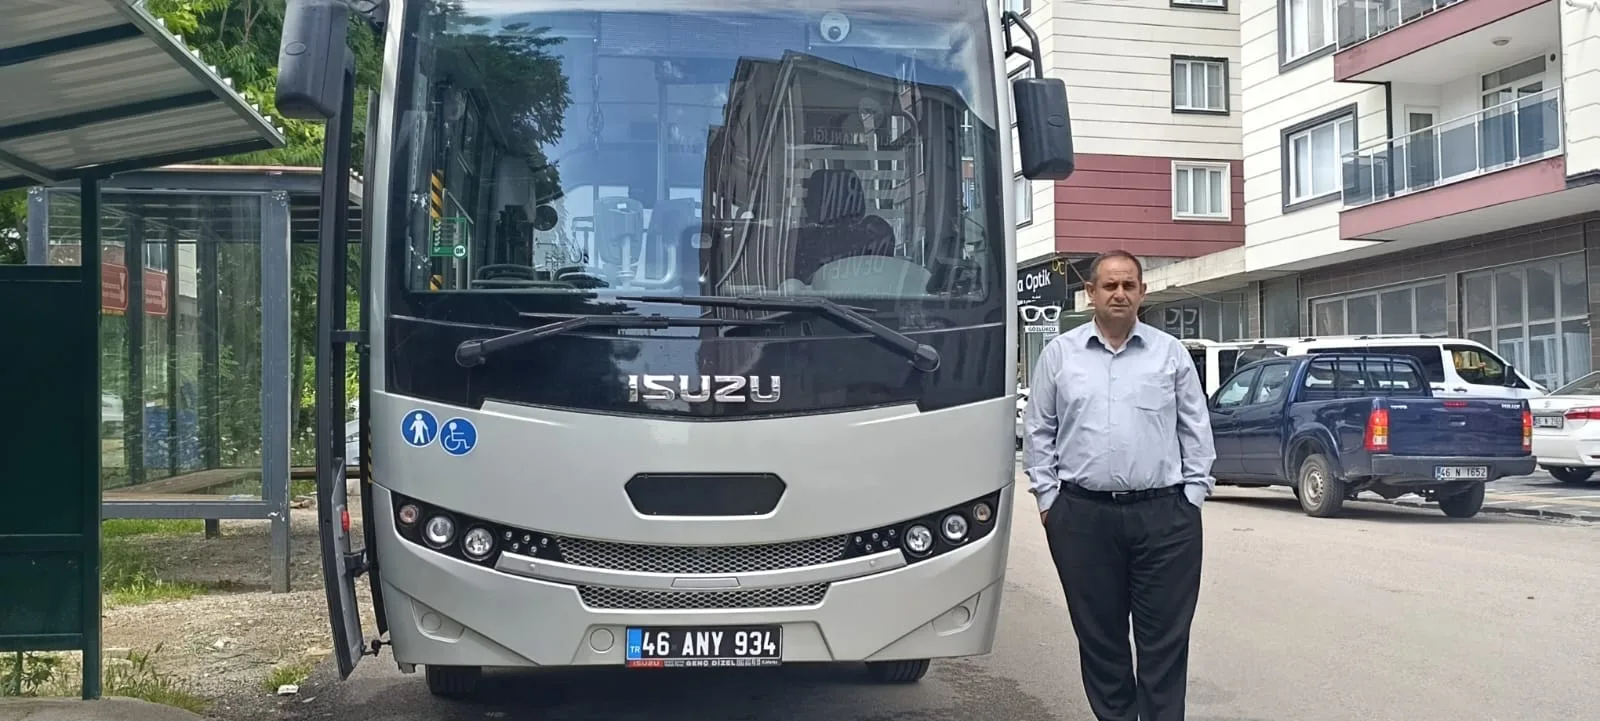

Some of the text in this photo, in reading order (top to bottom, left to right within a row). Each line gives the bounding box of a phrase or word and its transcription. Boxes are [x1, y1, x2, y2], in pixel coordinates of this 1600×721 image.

[1017, 268, 1052, 293] a Optik
[628, 374, 781, 403] ISUZU
[1440, 467, 1486, 477] 46 N 1652
[629, 630, 776, 656] TR 46 ANY 934
